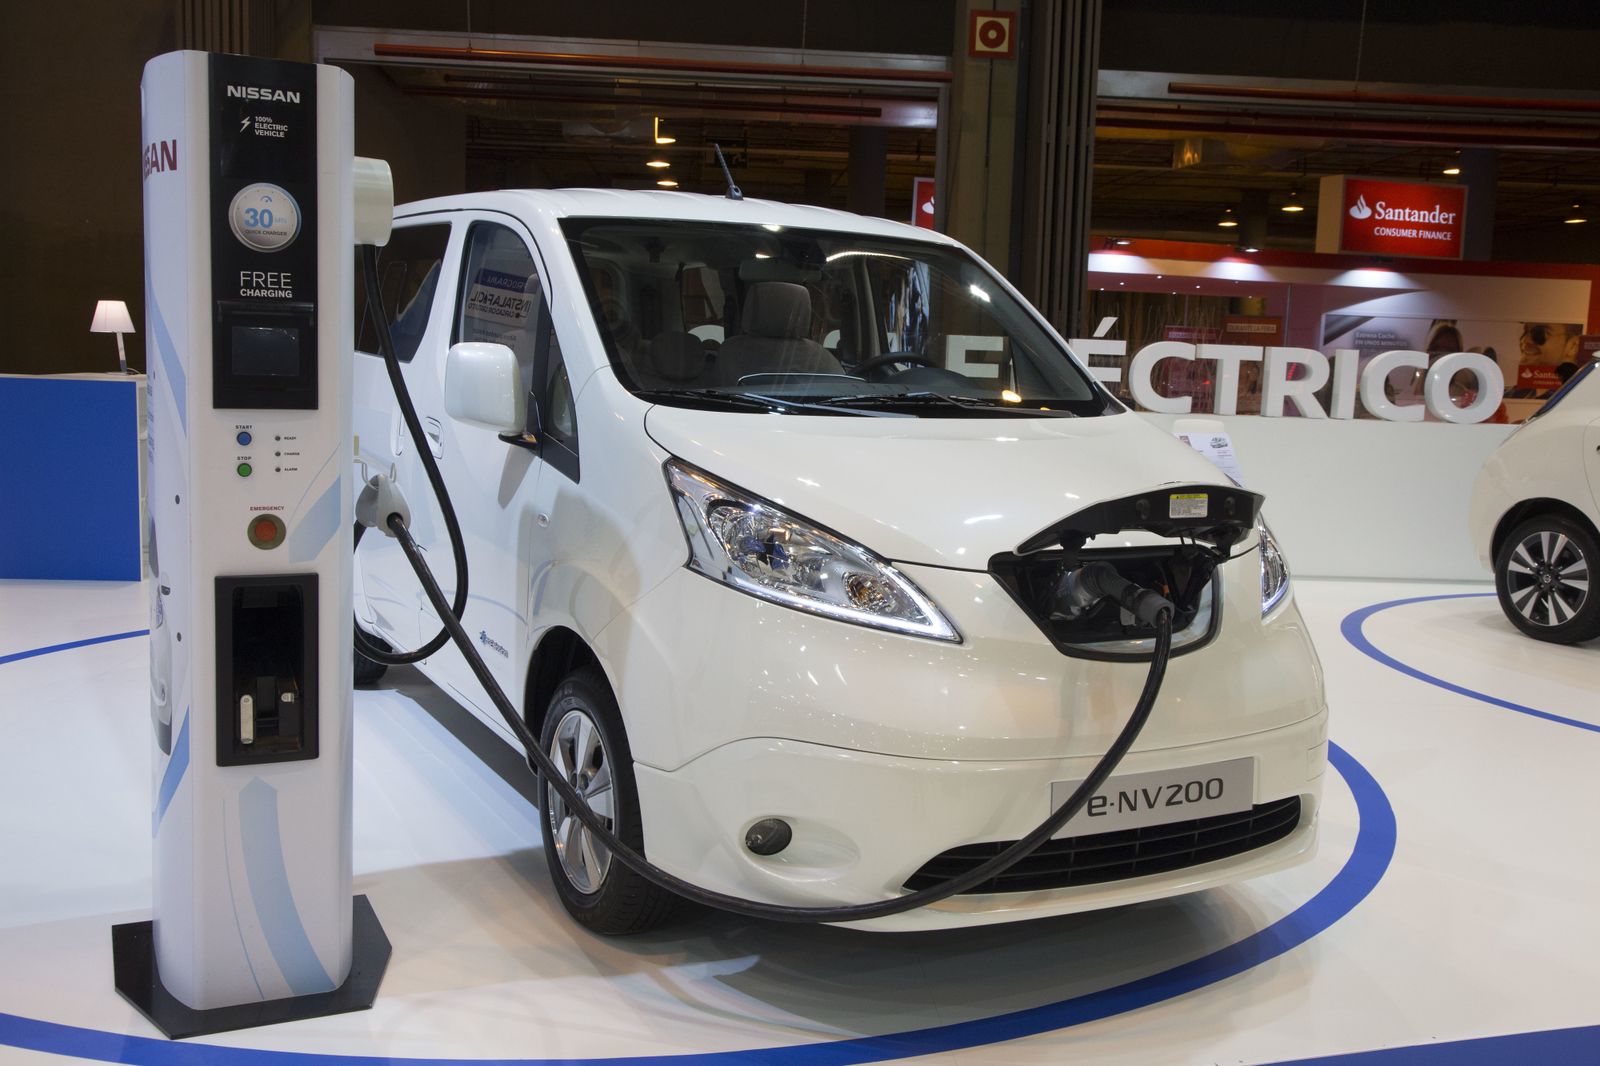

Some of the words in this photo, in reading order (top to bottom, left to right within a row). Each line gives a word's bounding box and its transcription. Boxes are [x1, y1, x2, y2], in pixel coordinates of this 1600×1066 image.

[227, 85, 300, 104] NISSAN
[254, 122, 288, 131] ELECTRIC
[254, 129, 285, 138] VEHICLE
[243, 207, 273, 229] 30
[1374, 201, 1456, 225] Santander
[1374, 226, 1417, 238] CONSUMER
[1418, 229, 1453, 240] FINANCE
[240, 271, 293, 289] FREE
[240, 288, 293, 298] CHARGING
